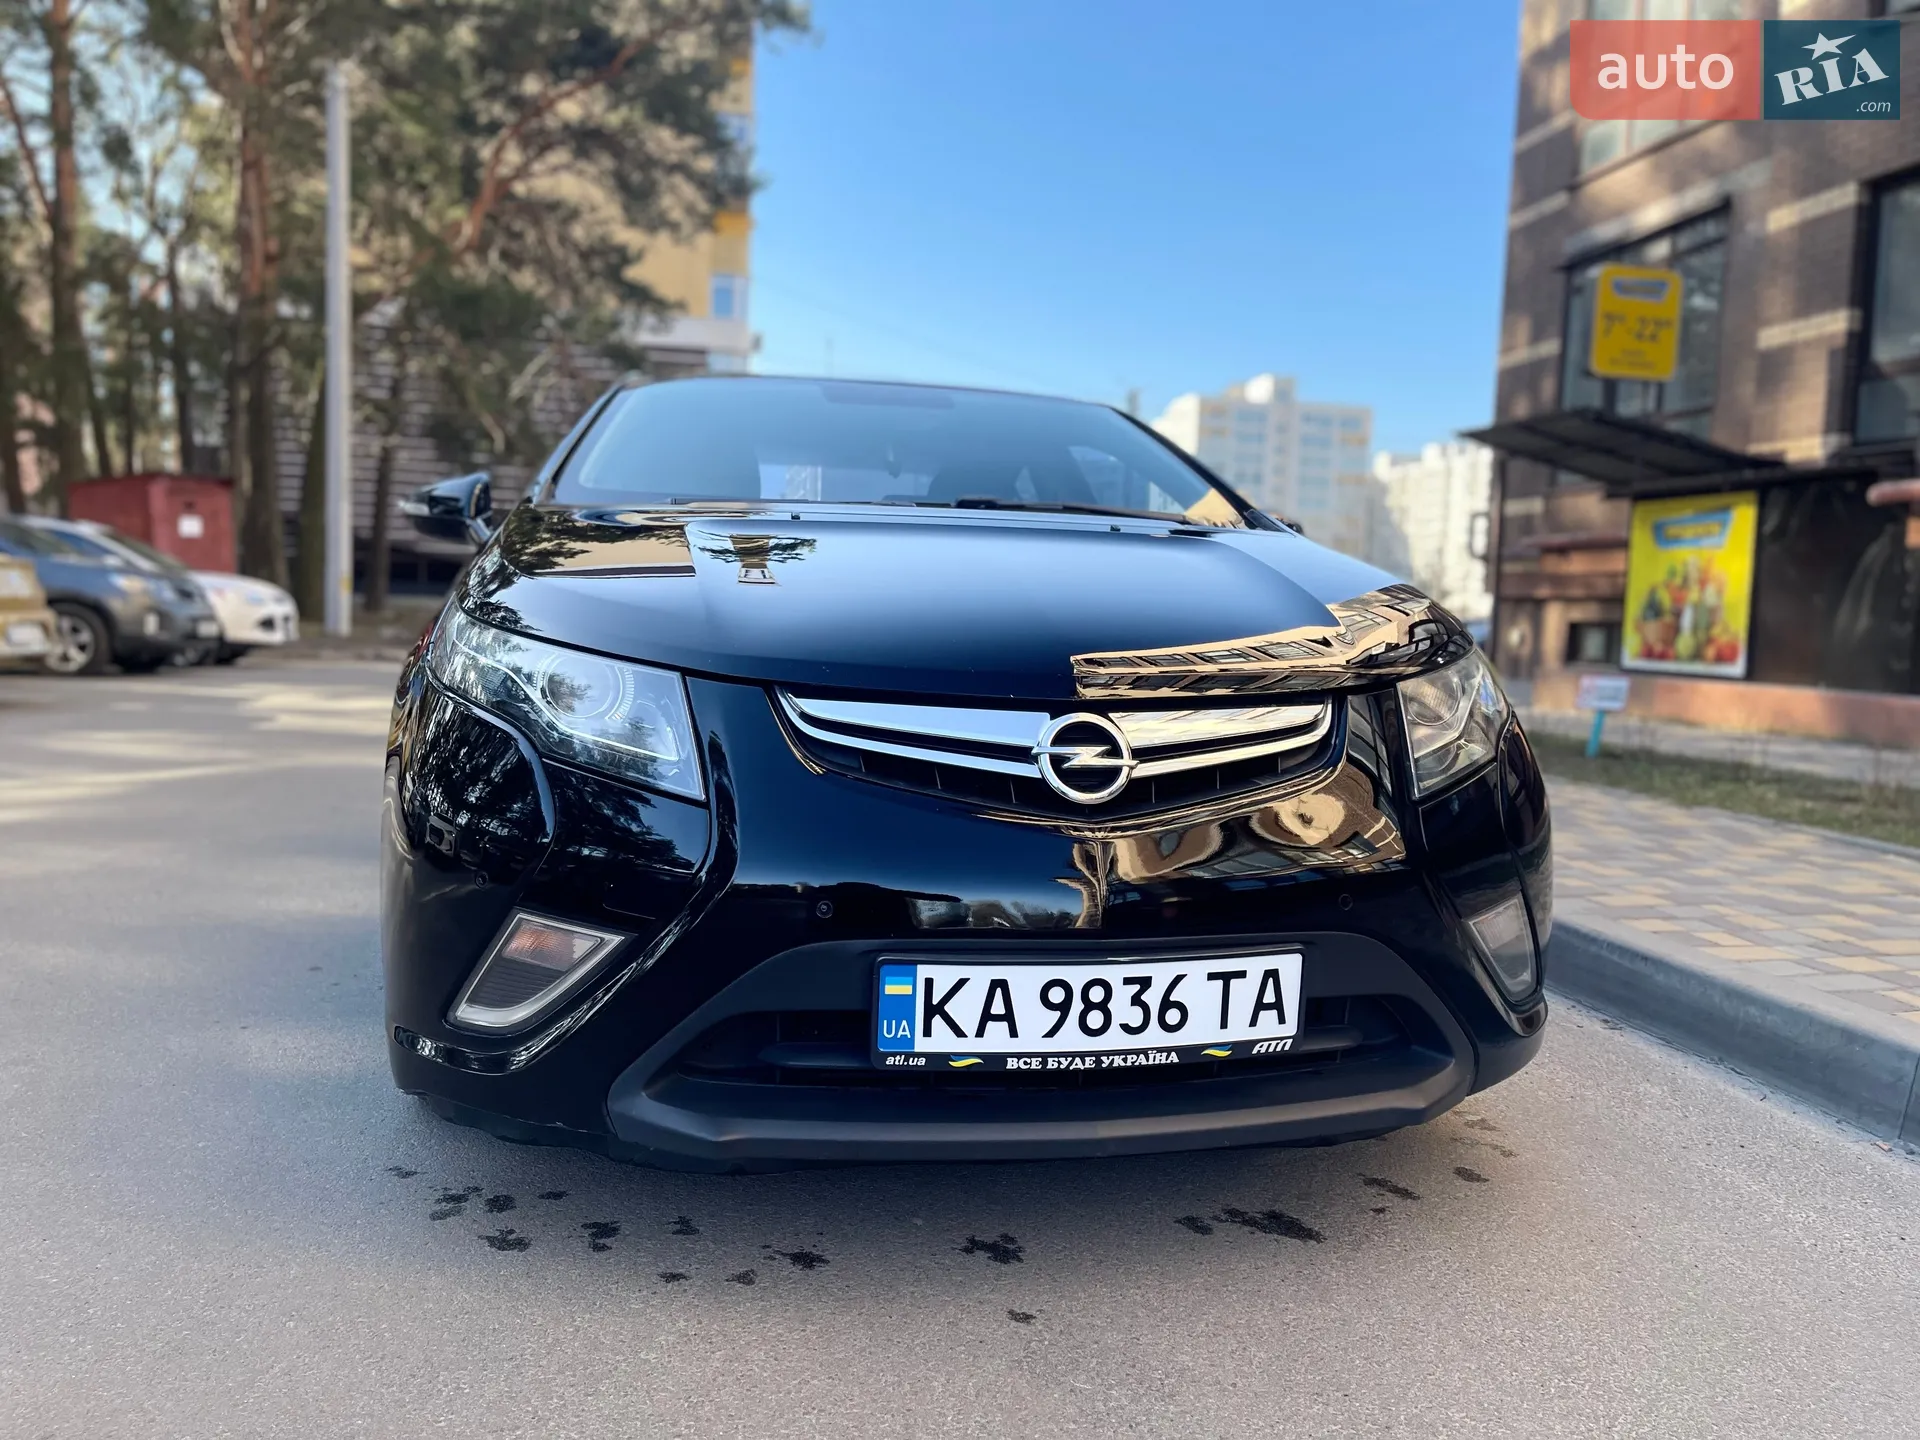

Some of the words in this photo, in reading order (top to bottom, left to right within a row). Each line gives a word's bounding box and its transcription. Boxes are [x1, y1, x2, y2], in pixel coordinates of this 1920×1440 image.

[922, 977, 1018, 1038] KA
[1039, 973, 1188, 1038] 9836
[1206, 968, 1287, 1030] TA
[883, 1019, 911, 1039] UA
[885, 1055, 926, 1067] atl.ua
[1006, 1056, 1043, 1070] ВСЕ
[1046, 1056, 1096, 1070] БУДЕ
[1101, 1051, 1179, 1069] УКРАЇНА
